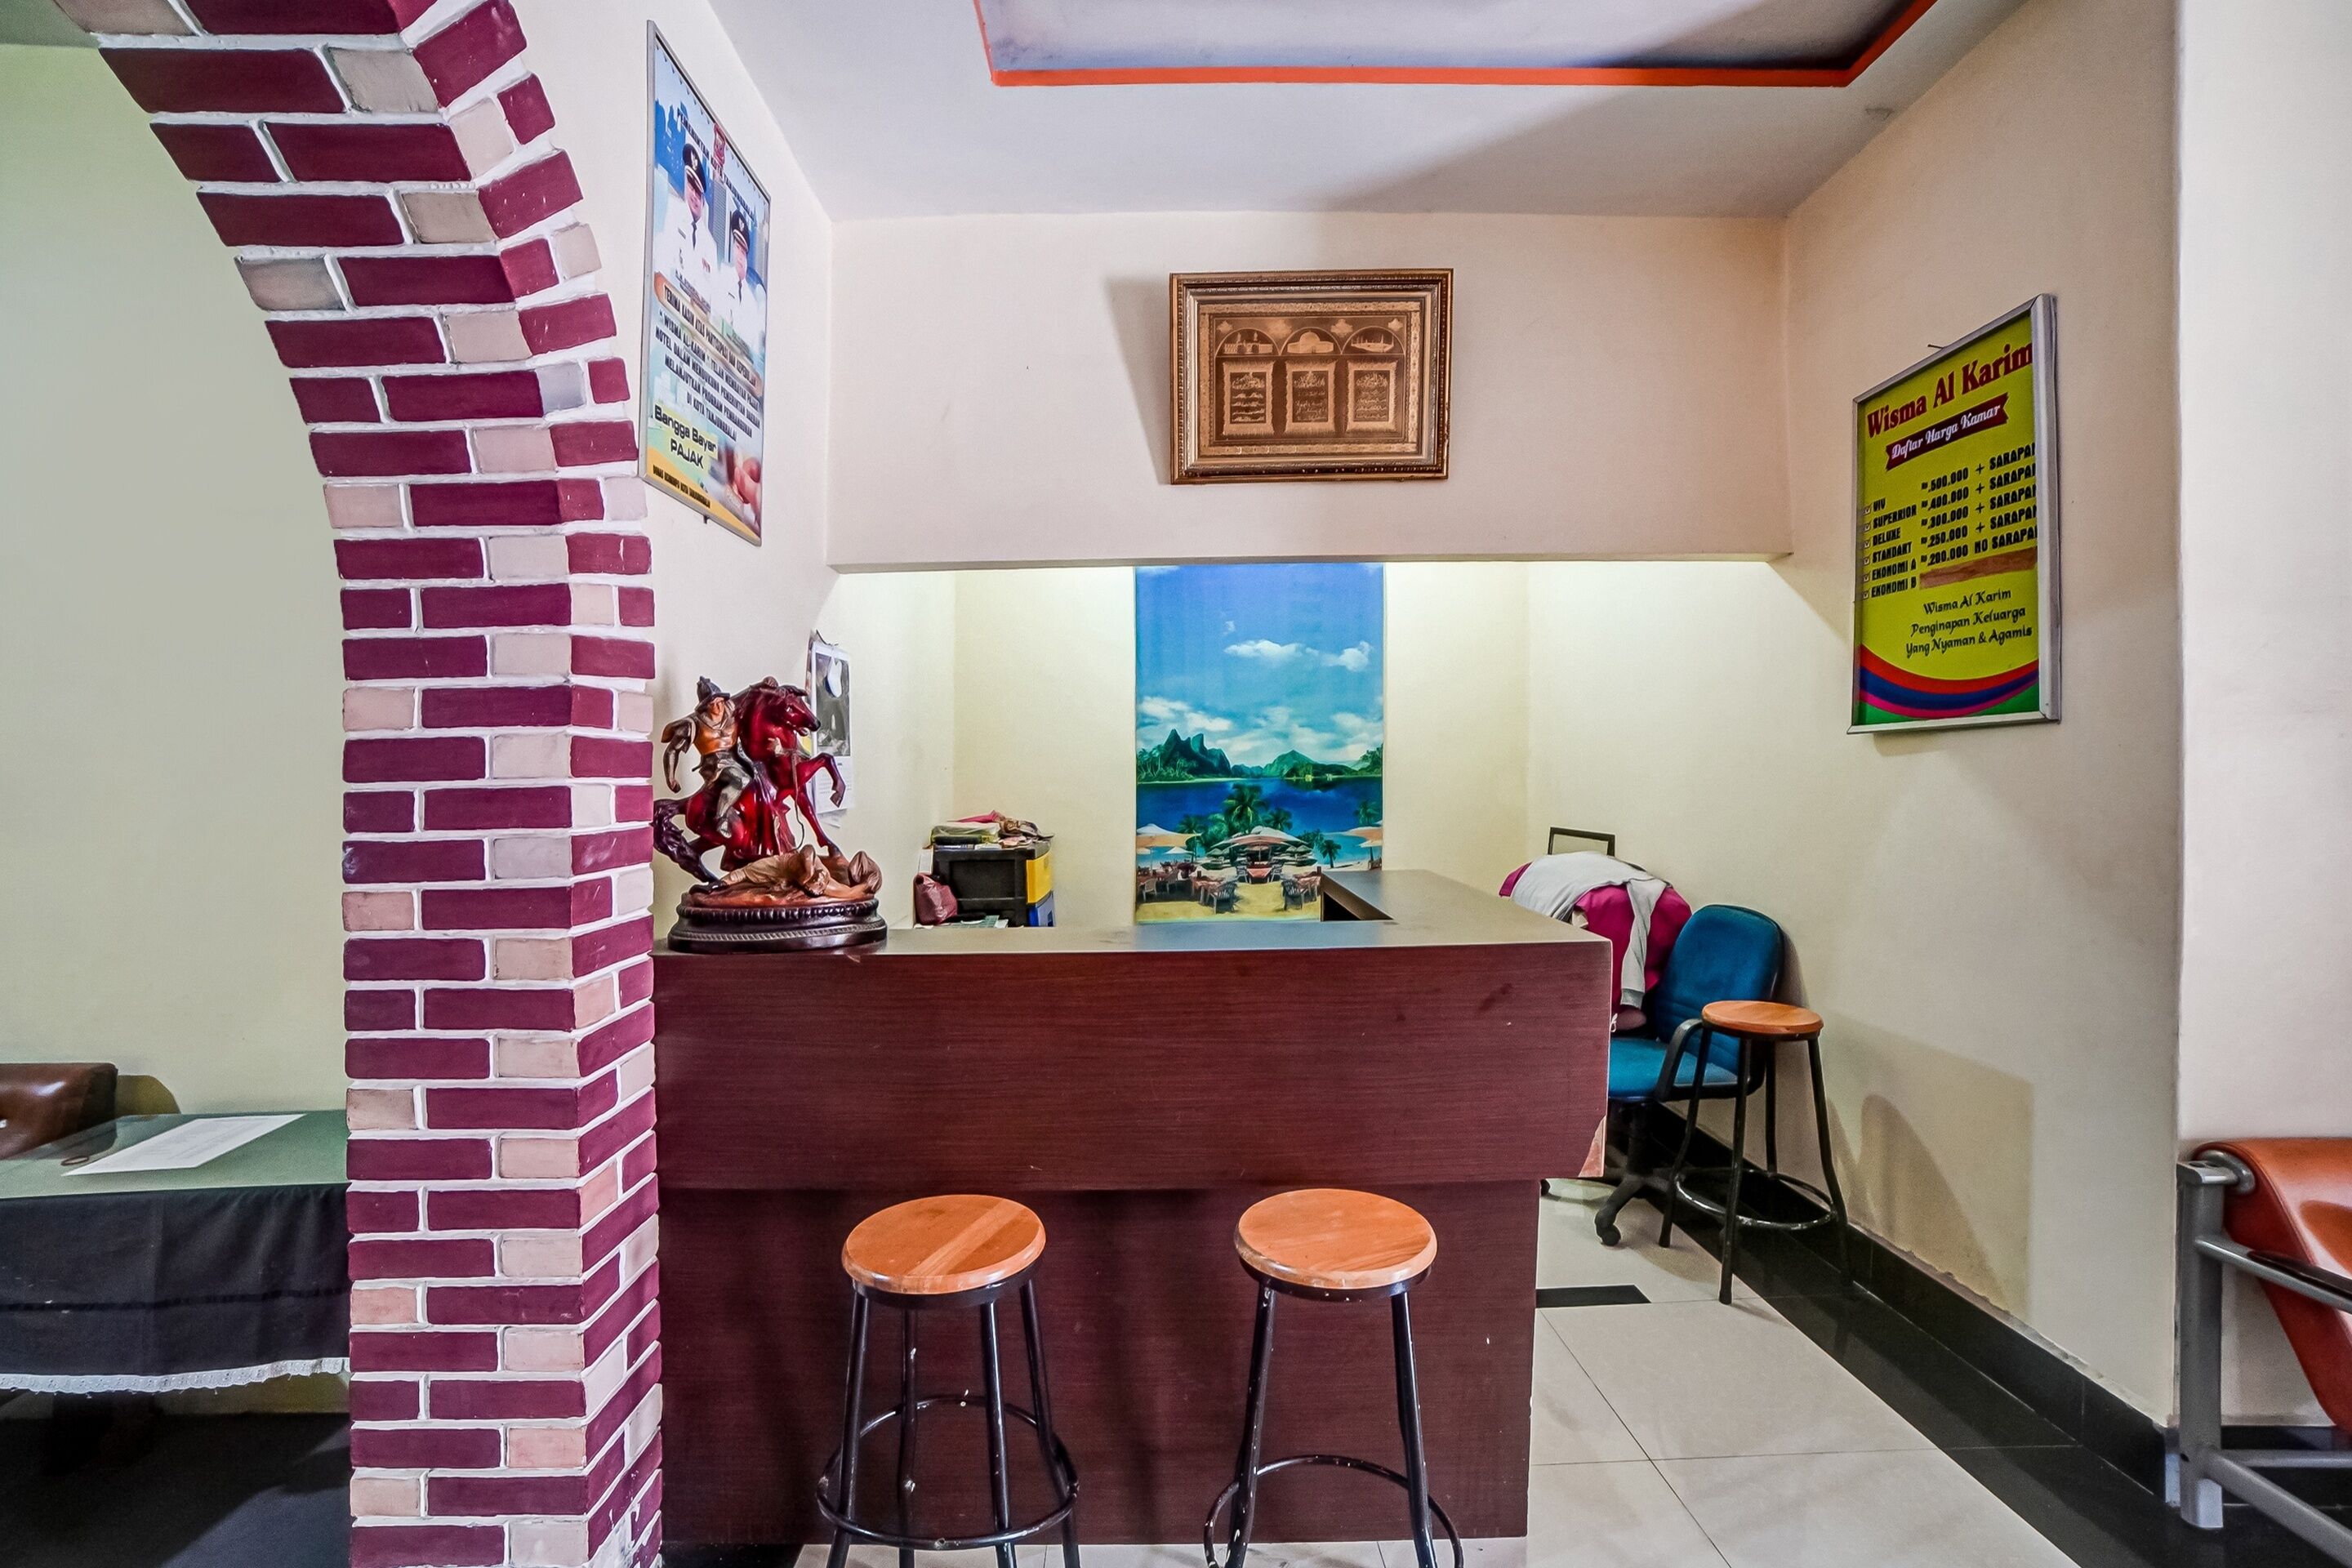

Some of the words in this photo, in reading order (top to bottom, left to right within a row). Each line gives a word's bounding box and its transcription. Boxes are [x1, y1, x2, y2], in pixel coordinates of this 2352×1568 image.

[663, 283, 681, 314] TERIMA
[664, 314, 683, 341] WISMA
[655, 324, 673, 353] HOTEL
[673, 341, 691, 368] DALAM
[1867, 395, 1927, 439] Wisma
[1932, 371, 1955, 409] Al
[1962, 342, 2033, 395] Karim
[693, 396, 705, 417] KOTA
[654, 404, 690, 439] Bangga
[692, 427, 717, 452] Bayar
[1891, 438, 1923, 460] Daftar
[1925, 423, 1958, 445] Harga
[1960, 404, 2001, 430] Kamar
[670, 438, 704, 470] PAJAK
[1872, 527, 1901, 547] DELUXE
[1872, 541, 1913, 564] STANDART
[1872, 559, 1909, 581] EKONOMI
[1910, 558, 1917, 571] A
[1974, 538, 1989, 555] NO
[1871, 578, 1909, 599] EKONOMI
[1910, 576, 1917, 589] B
[1922, 600, 1959, 615] Wisma
[1959, 593, 1973, 609] Al
[1975, 589, 2011, 606] Karim
[1910, 617, 1971, 638] Penginapan
[1972, 607, 2026, 626] Keluarga
[1905, 642, 1931, 659] Yang
[1931, 636, 1976, 655] Nyaman
[1978, 630, 1987, 644] &
[1988, 624, 2033, 646] Agamis
